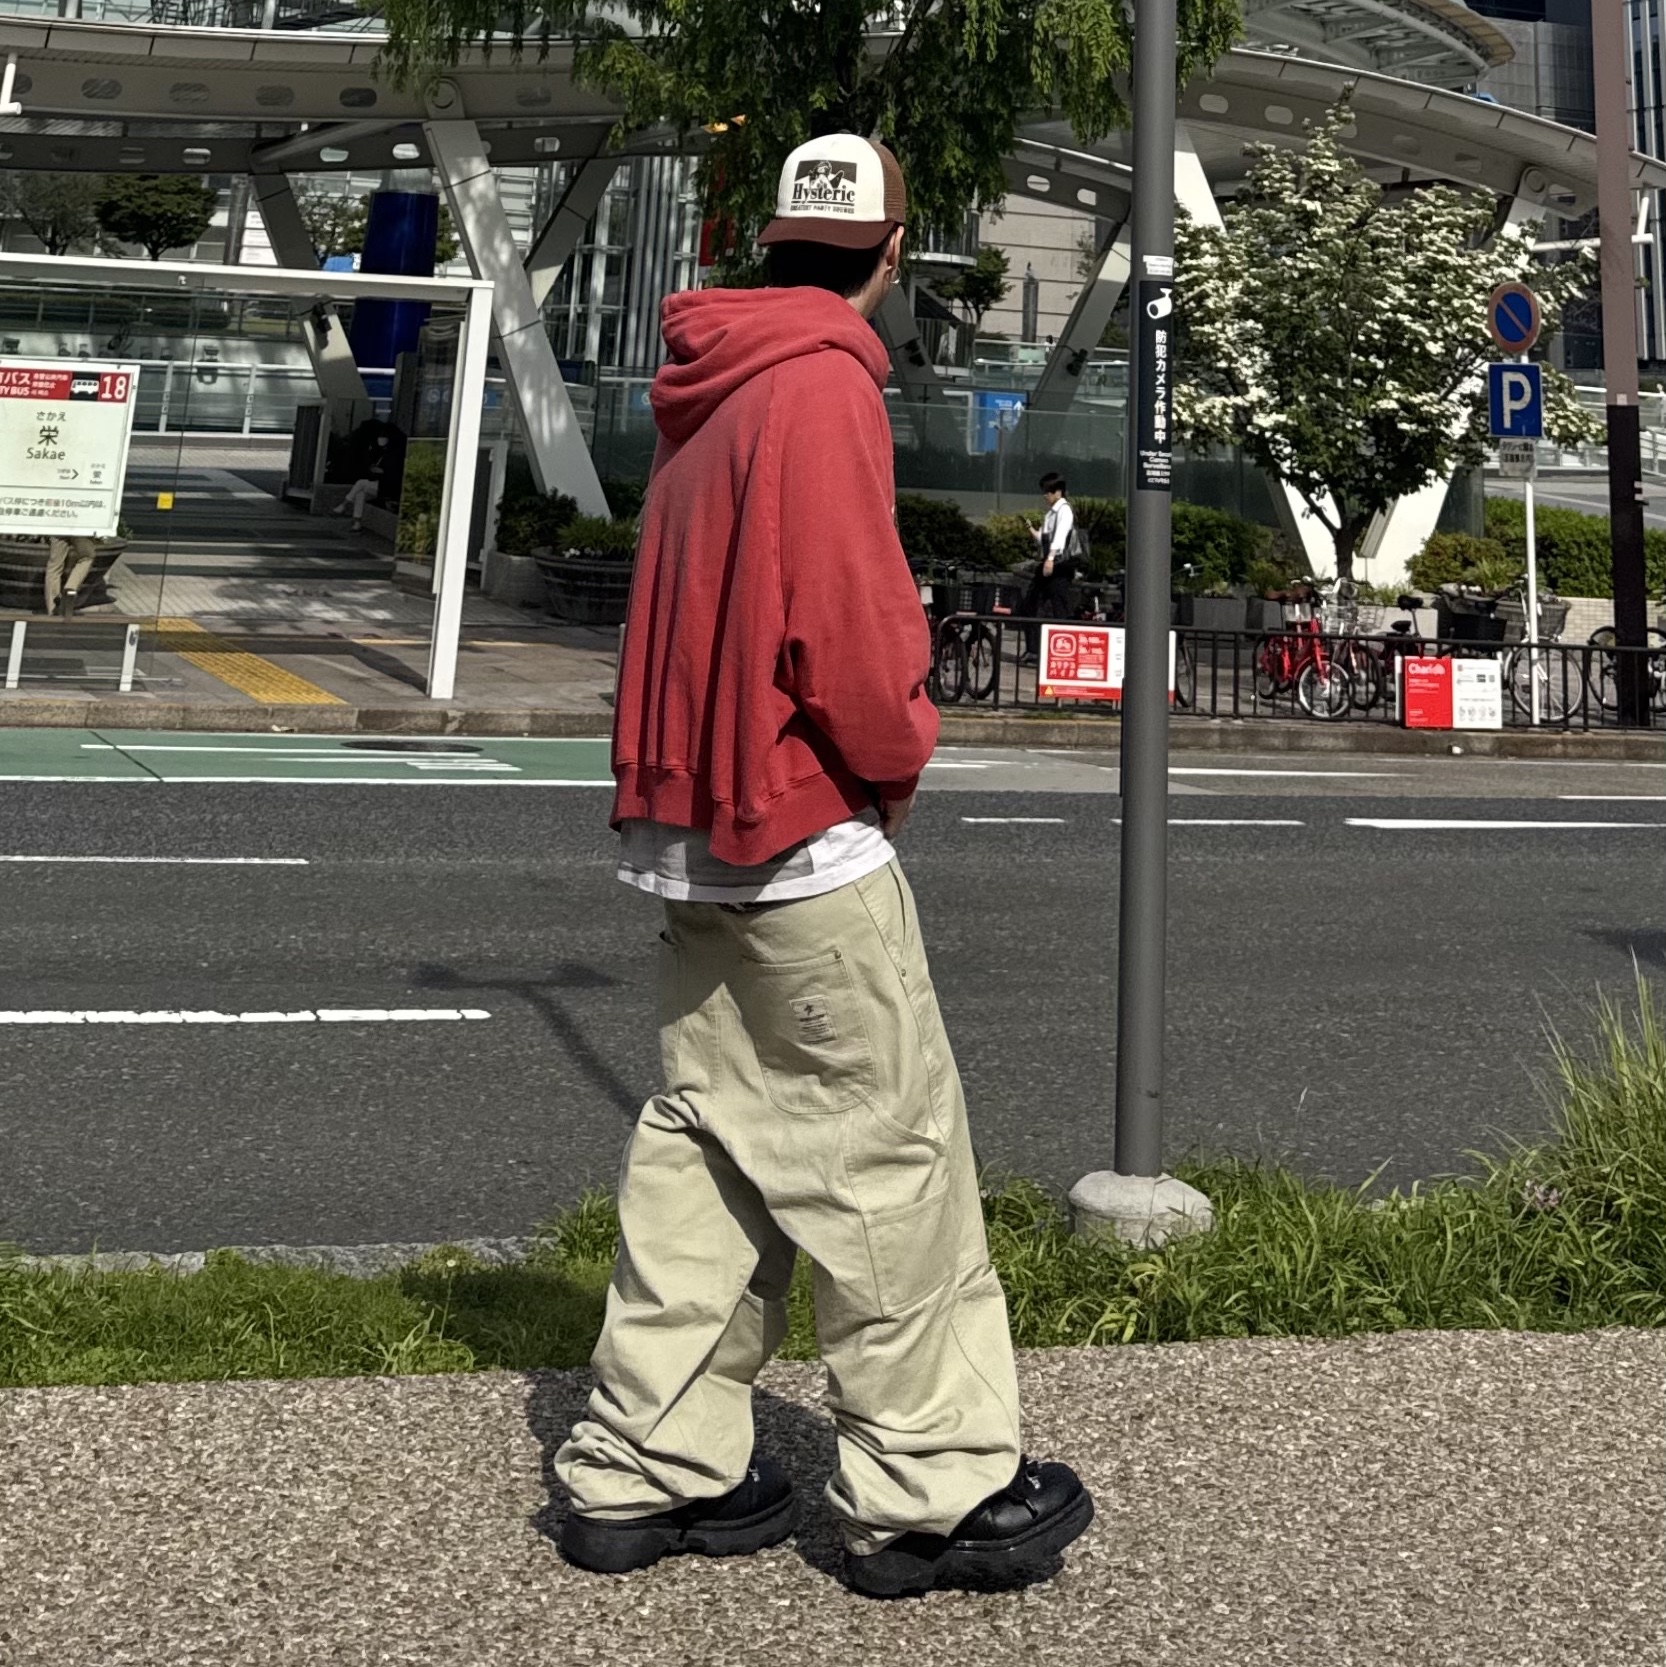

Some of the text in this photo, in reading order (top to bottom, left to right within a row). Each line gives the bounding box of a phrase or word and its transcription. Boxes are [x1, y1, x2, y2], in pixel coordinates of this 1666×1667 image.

[792, 183, 855, 204] Hysteric
[10, 386, 30, 396] BUS
[101, 375, 127, 400] 18
[1154, 329, 1168, 445] 防犯カメラ作動中
[1501, 371, 1533, 429] P
[36, 411, 67, 422] さかえ
[38, 425, 60, 446] 栄
[26, 446, 66, 461] Sakae
